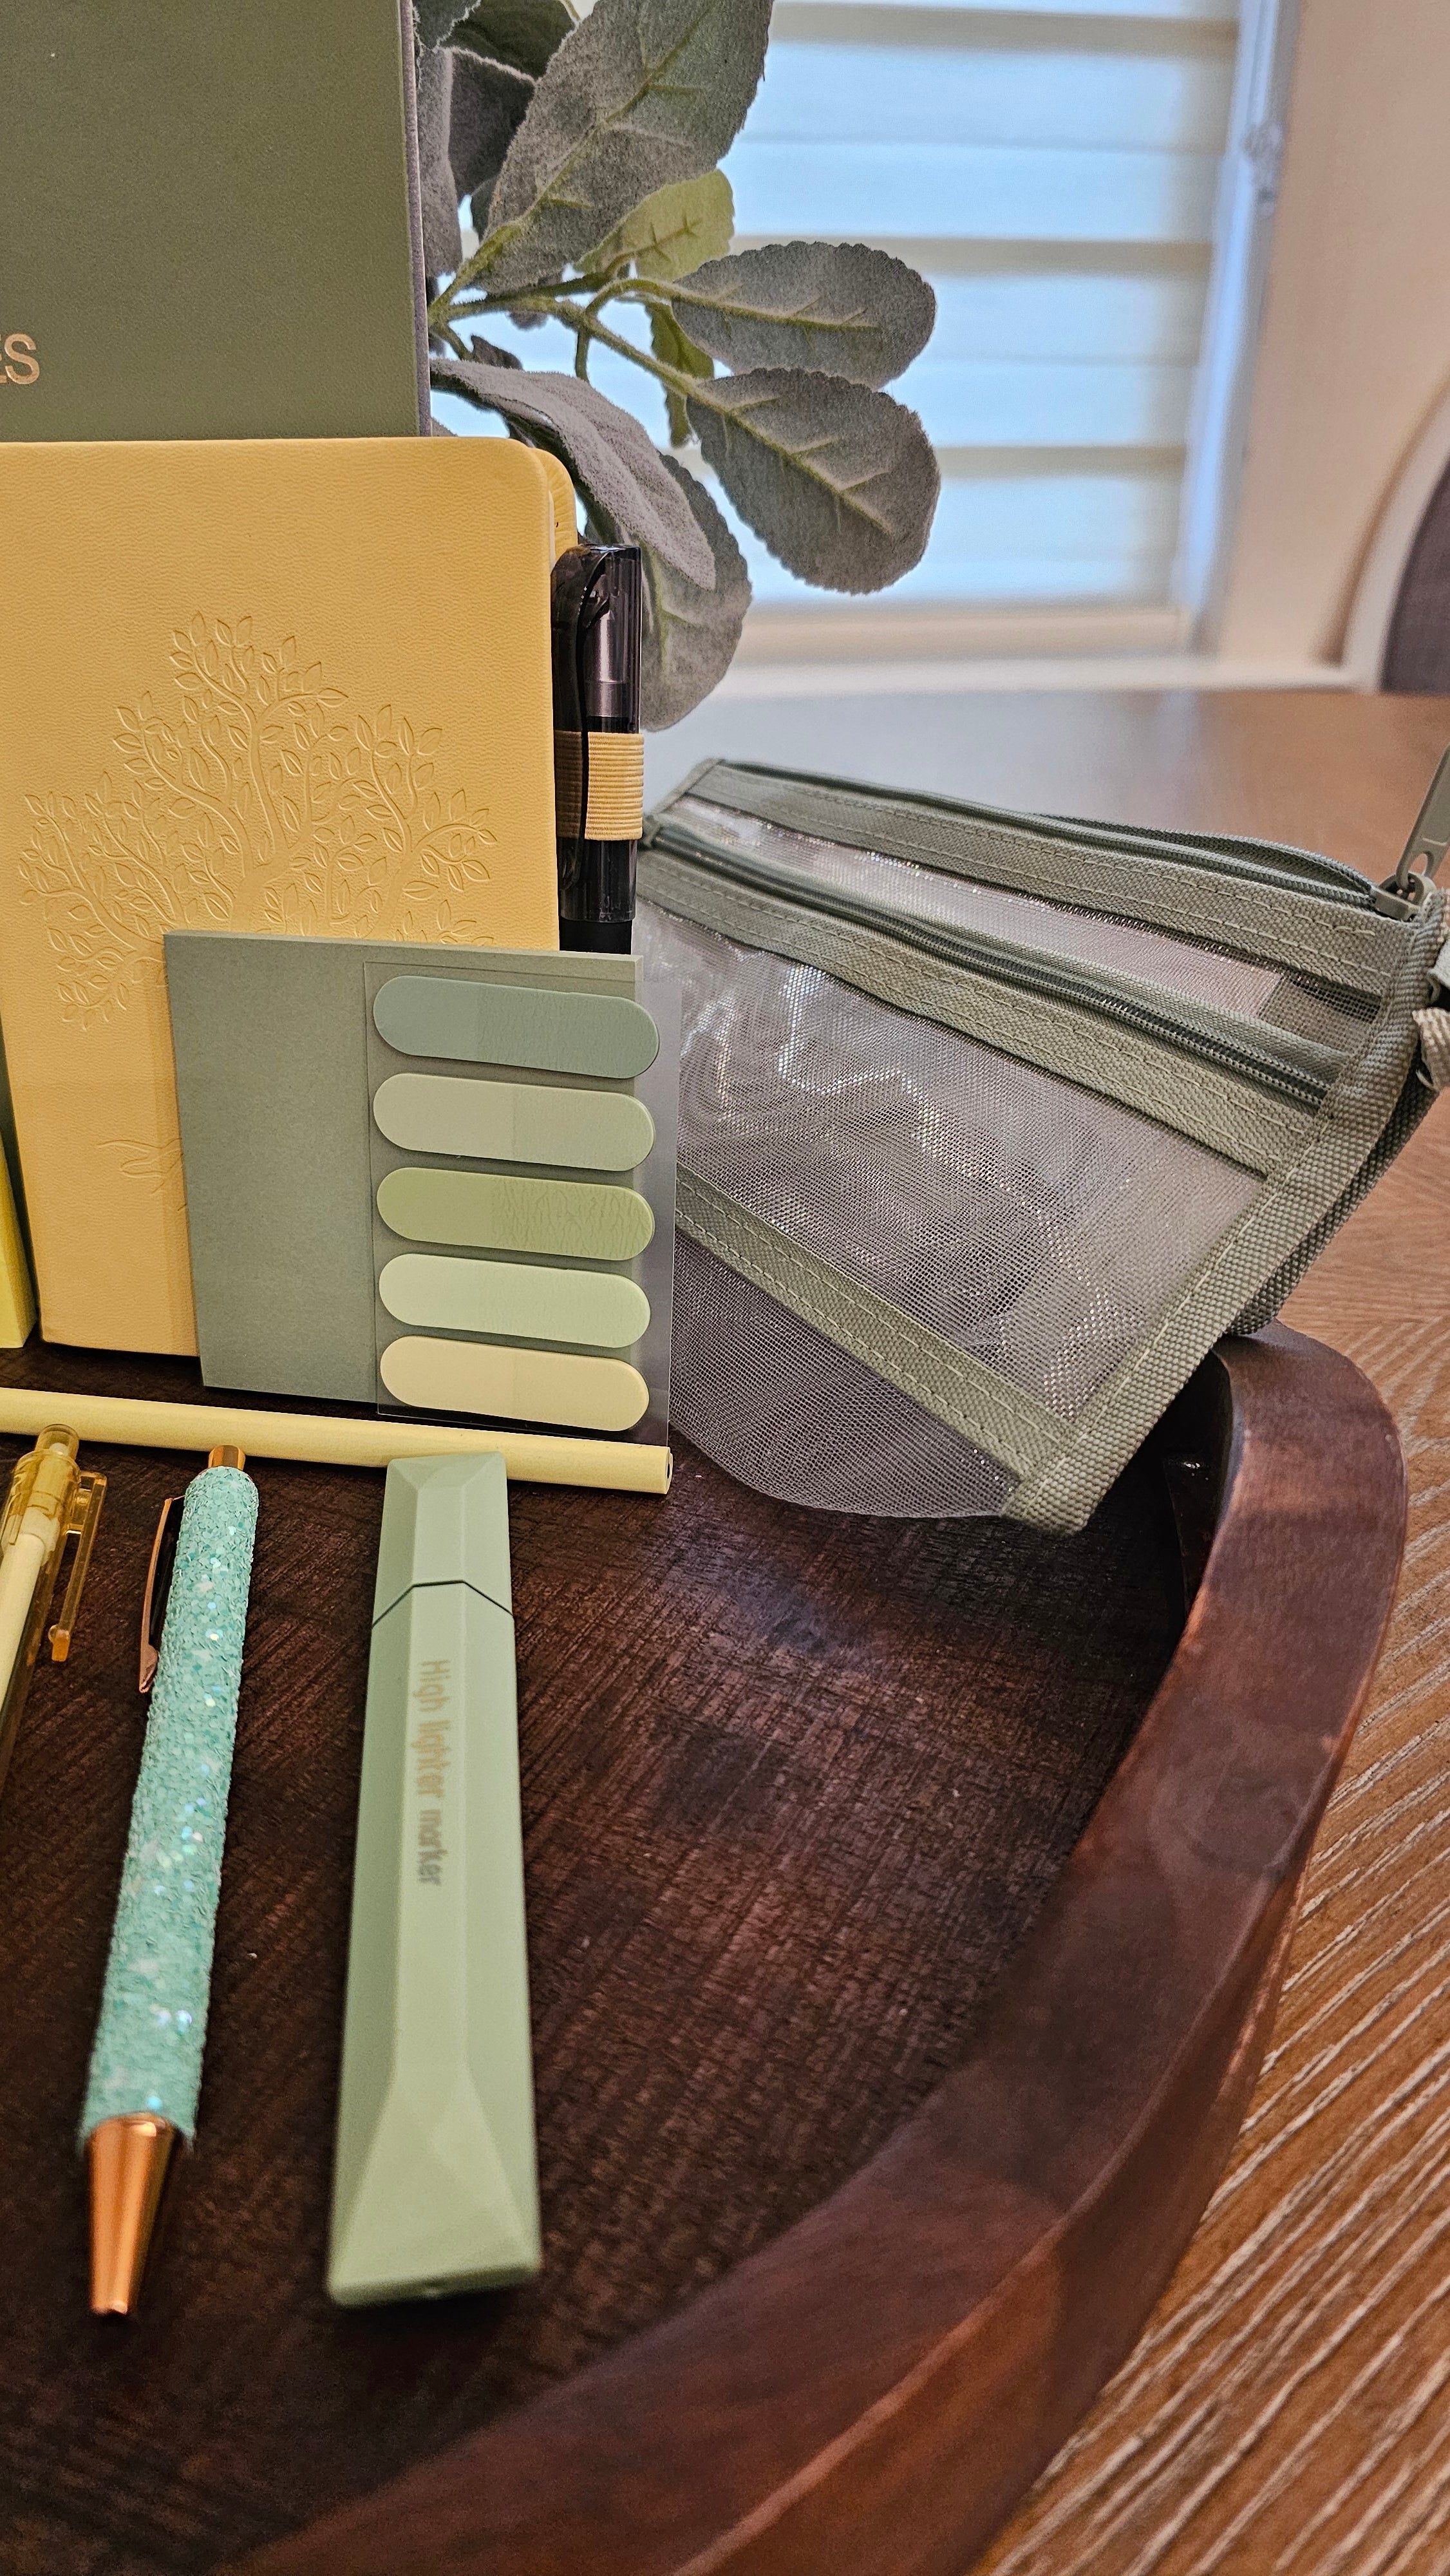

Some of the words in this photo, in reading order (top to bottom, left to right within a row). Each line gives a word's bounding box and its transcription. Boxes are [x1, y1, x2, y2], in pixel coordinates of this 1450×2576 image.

[0, 333, 40, 385] S
[413, 1659, 451, 1712] High
[411, 1720, 451, 1799] lighter
[417, 1808, 449, 1887] marker
